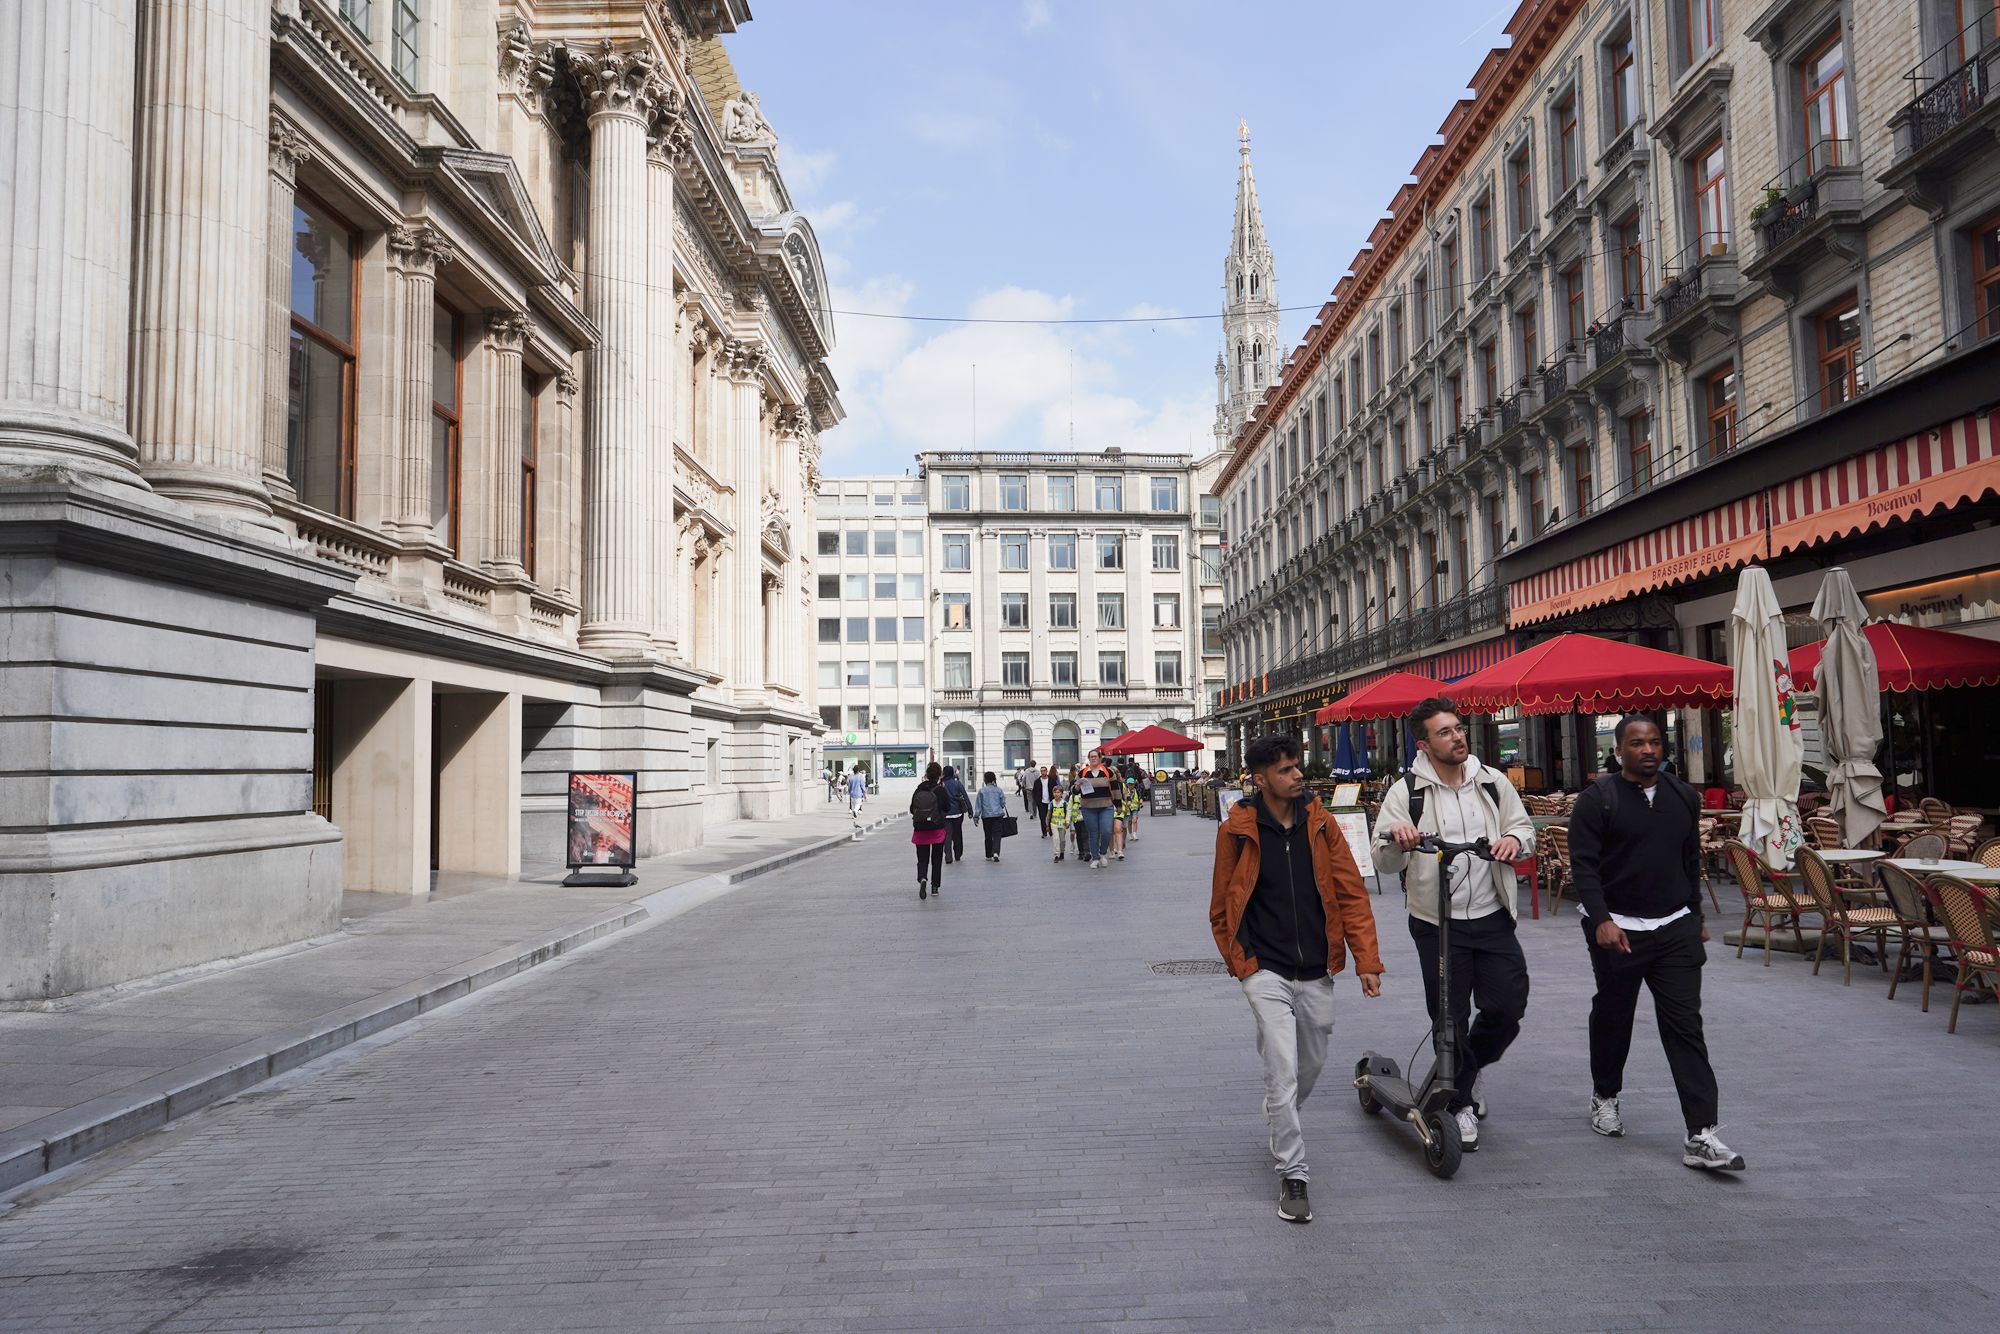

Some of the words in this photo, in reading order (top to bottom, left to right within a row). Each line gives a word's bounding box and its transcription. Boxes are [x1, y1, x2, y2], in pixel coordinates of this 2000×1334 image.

[1867, 487, 1922, 517] Boemvol
[1652, 558, 1698, 580] BRASSERIE
[1700, 547, 1731, 566] BELGE
